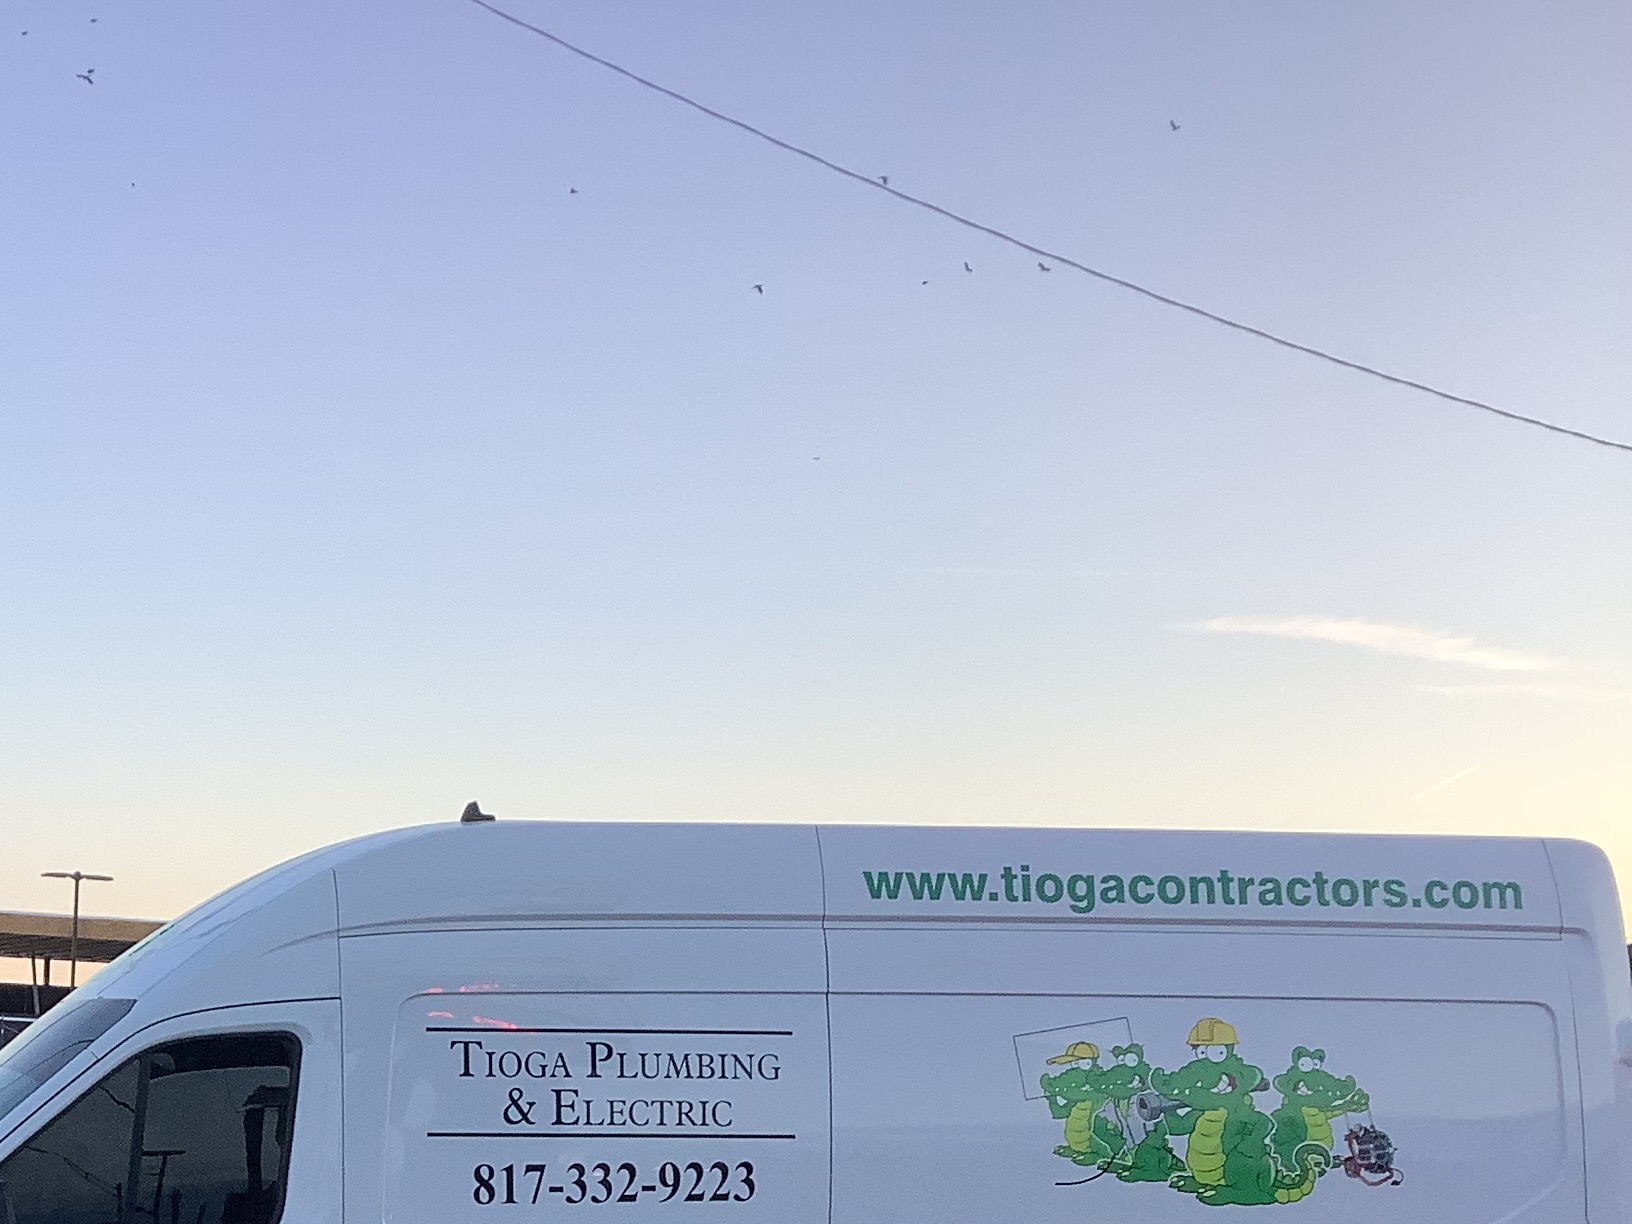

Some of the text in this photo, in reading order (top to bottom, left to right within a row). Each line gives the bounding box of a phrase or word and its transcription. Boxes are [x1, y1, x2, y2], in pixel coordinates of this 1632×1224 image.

[862, 864, 1524, 914] www.tiogacontractors.com
[450, 1040, 781, 1081] TIOGA PLUMBING
[503, 1087, 733, 1127] & ELECTRIC
[472, 1161, 756, 1205] 817-332-9223
